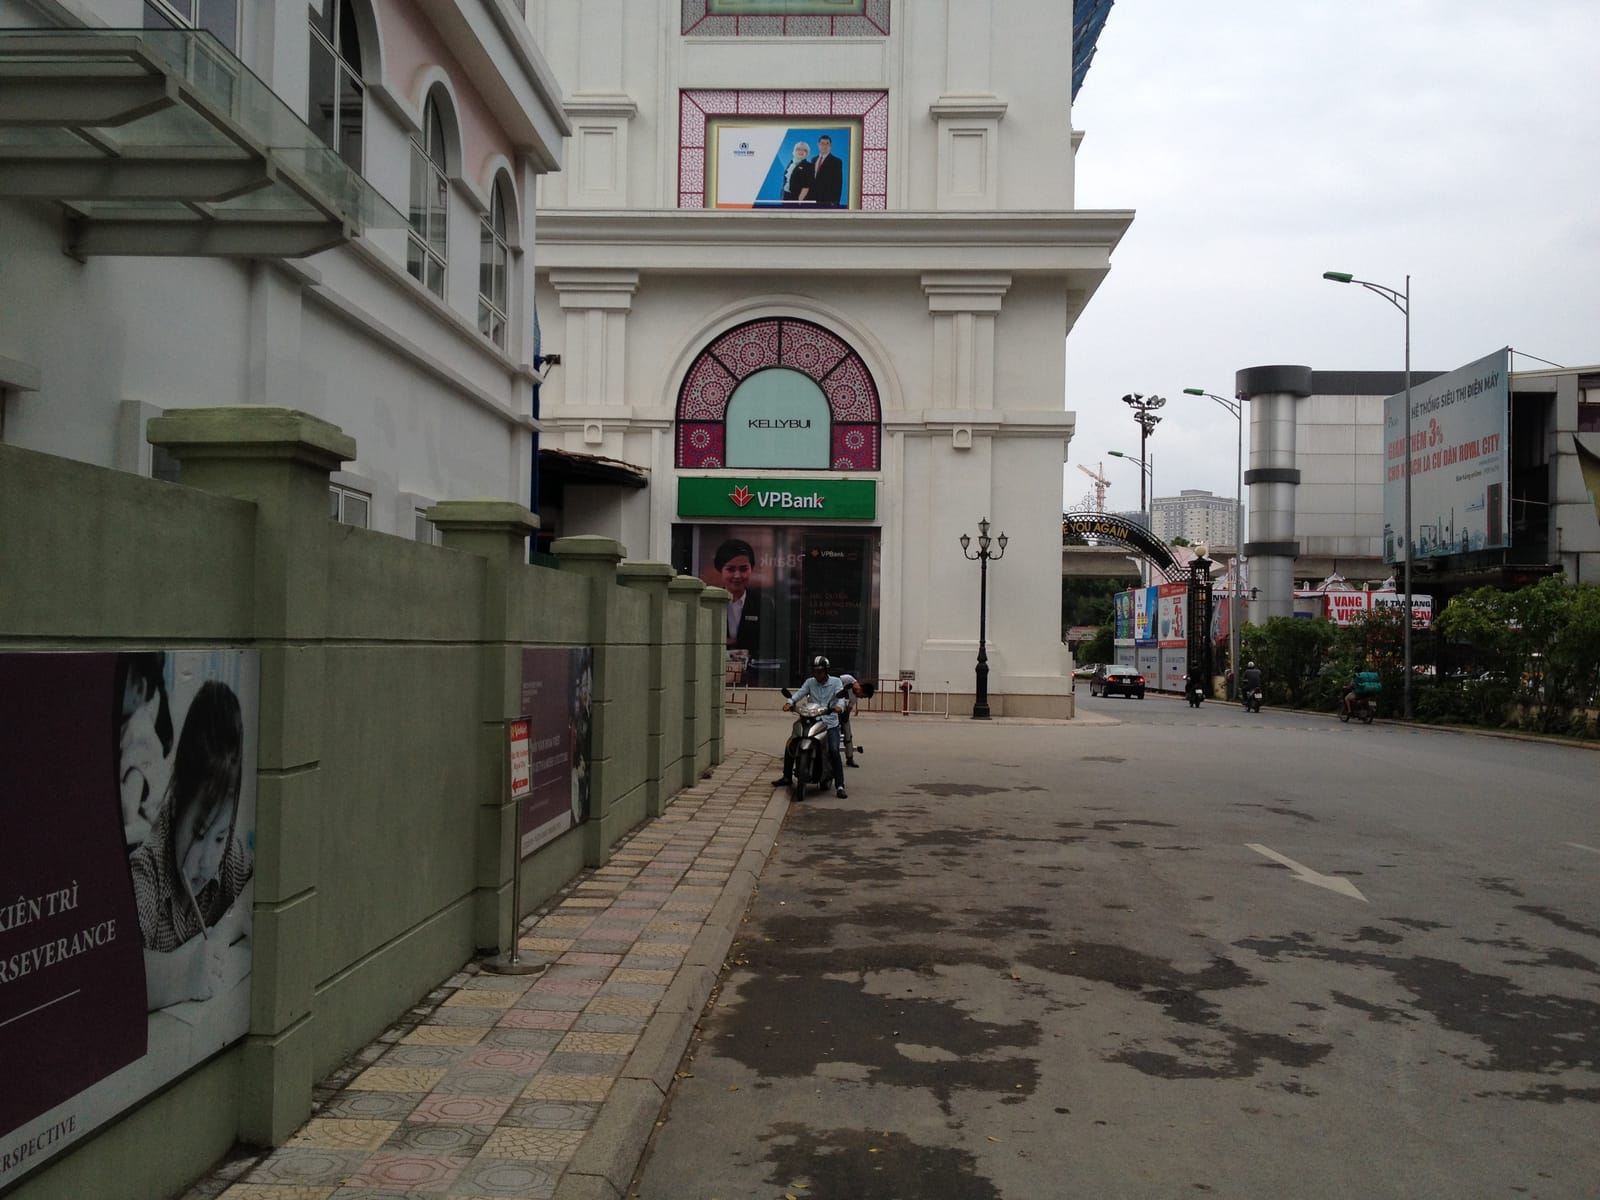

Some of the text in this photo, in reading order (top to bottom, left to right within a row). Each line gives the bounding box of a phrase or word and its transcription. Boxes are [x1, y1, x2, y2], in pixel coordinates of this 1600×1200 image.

[1440, 389, 1455, 408] SIÊU
[748, 419, 811, 429] KELLYBUI
[1428, 418, 1444, 448] 3%
[1459, 439, 1480, 462] ROYAL
[1482, 432, 1501, 455] CITY
[757, 491, 825, 509] VPBank
[1071, 522, 1091, 533] YOU
[1093, 522, 1129, 539] AGAIN
[45, 879, 79, 917] TRÌ
